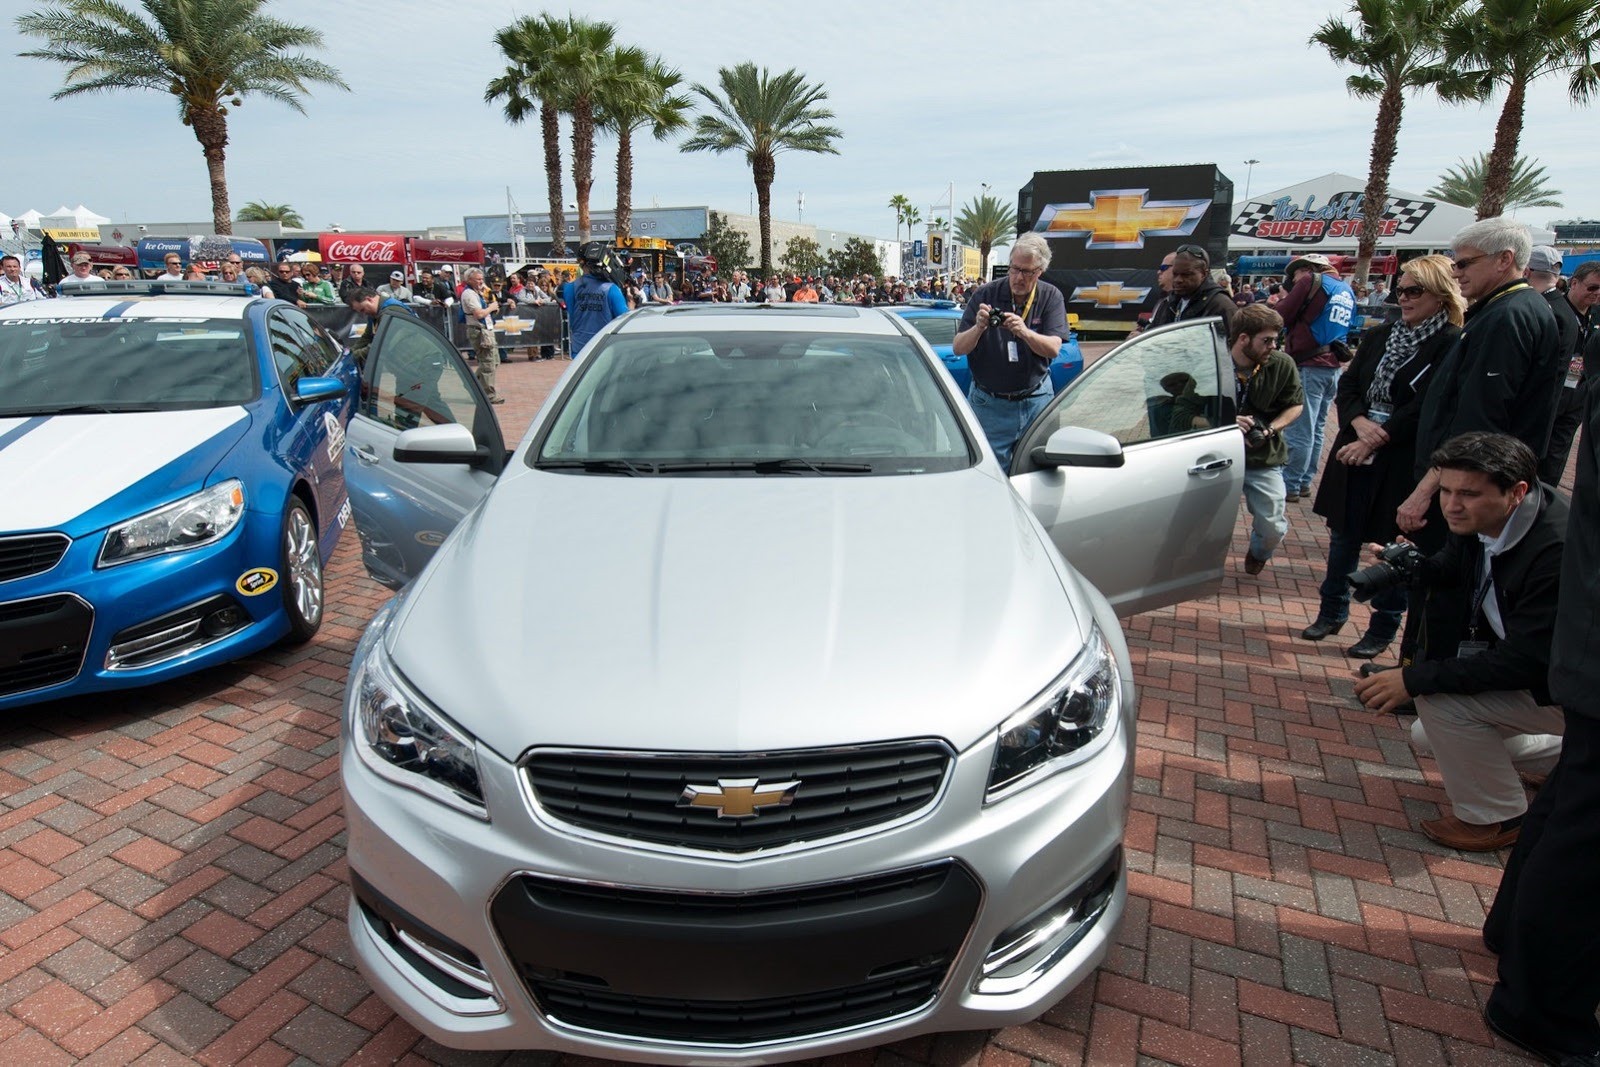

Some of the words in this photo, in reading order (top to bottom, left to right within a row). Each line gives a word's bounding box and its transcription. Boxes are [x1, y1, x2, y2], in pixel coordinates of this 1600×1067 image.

[1272, 195, 1298, 221] The
[1299, 194, 1349, 221] Last
[640, 222, 656, 230] OF
[1255, 220, 1325, 238] SUPER
[1327, 219, 1400, 238] STRE
[248, 251, 264, 259] Cream
[2, 317, 139, 326] CHEVROLET
